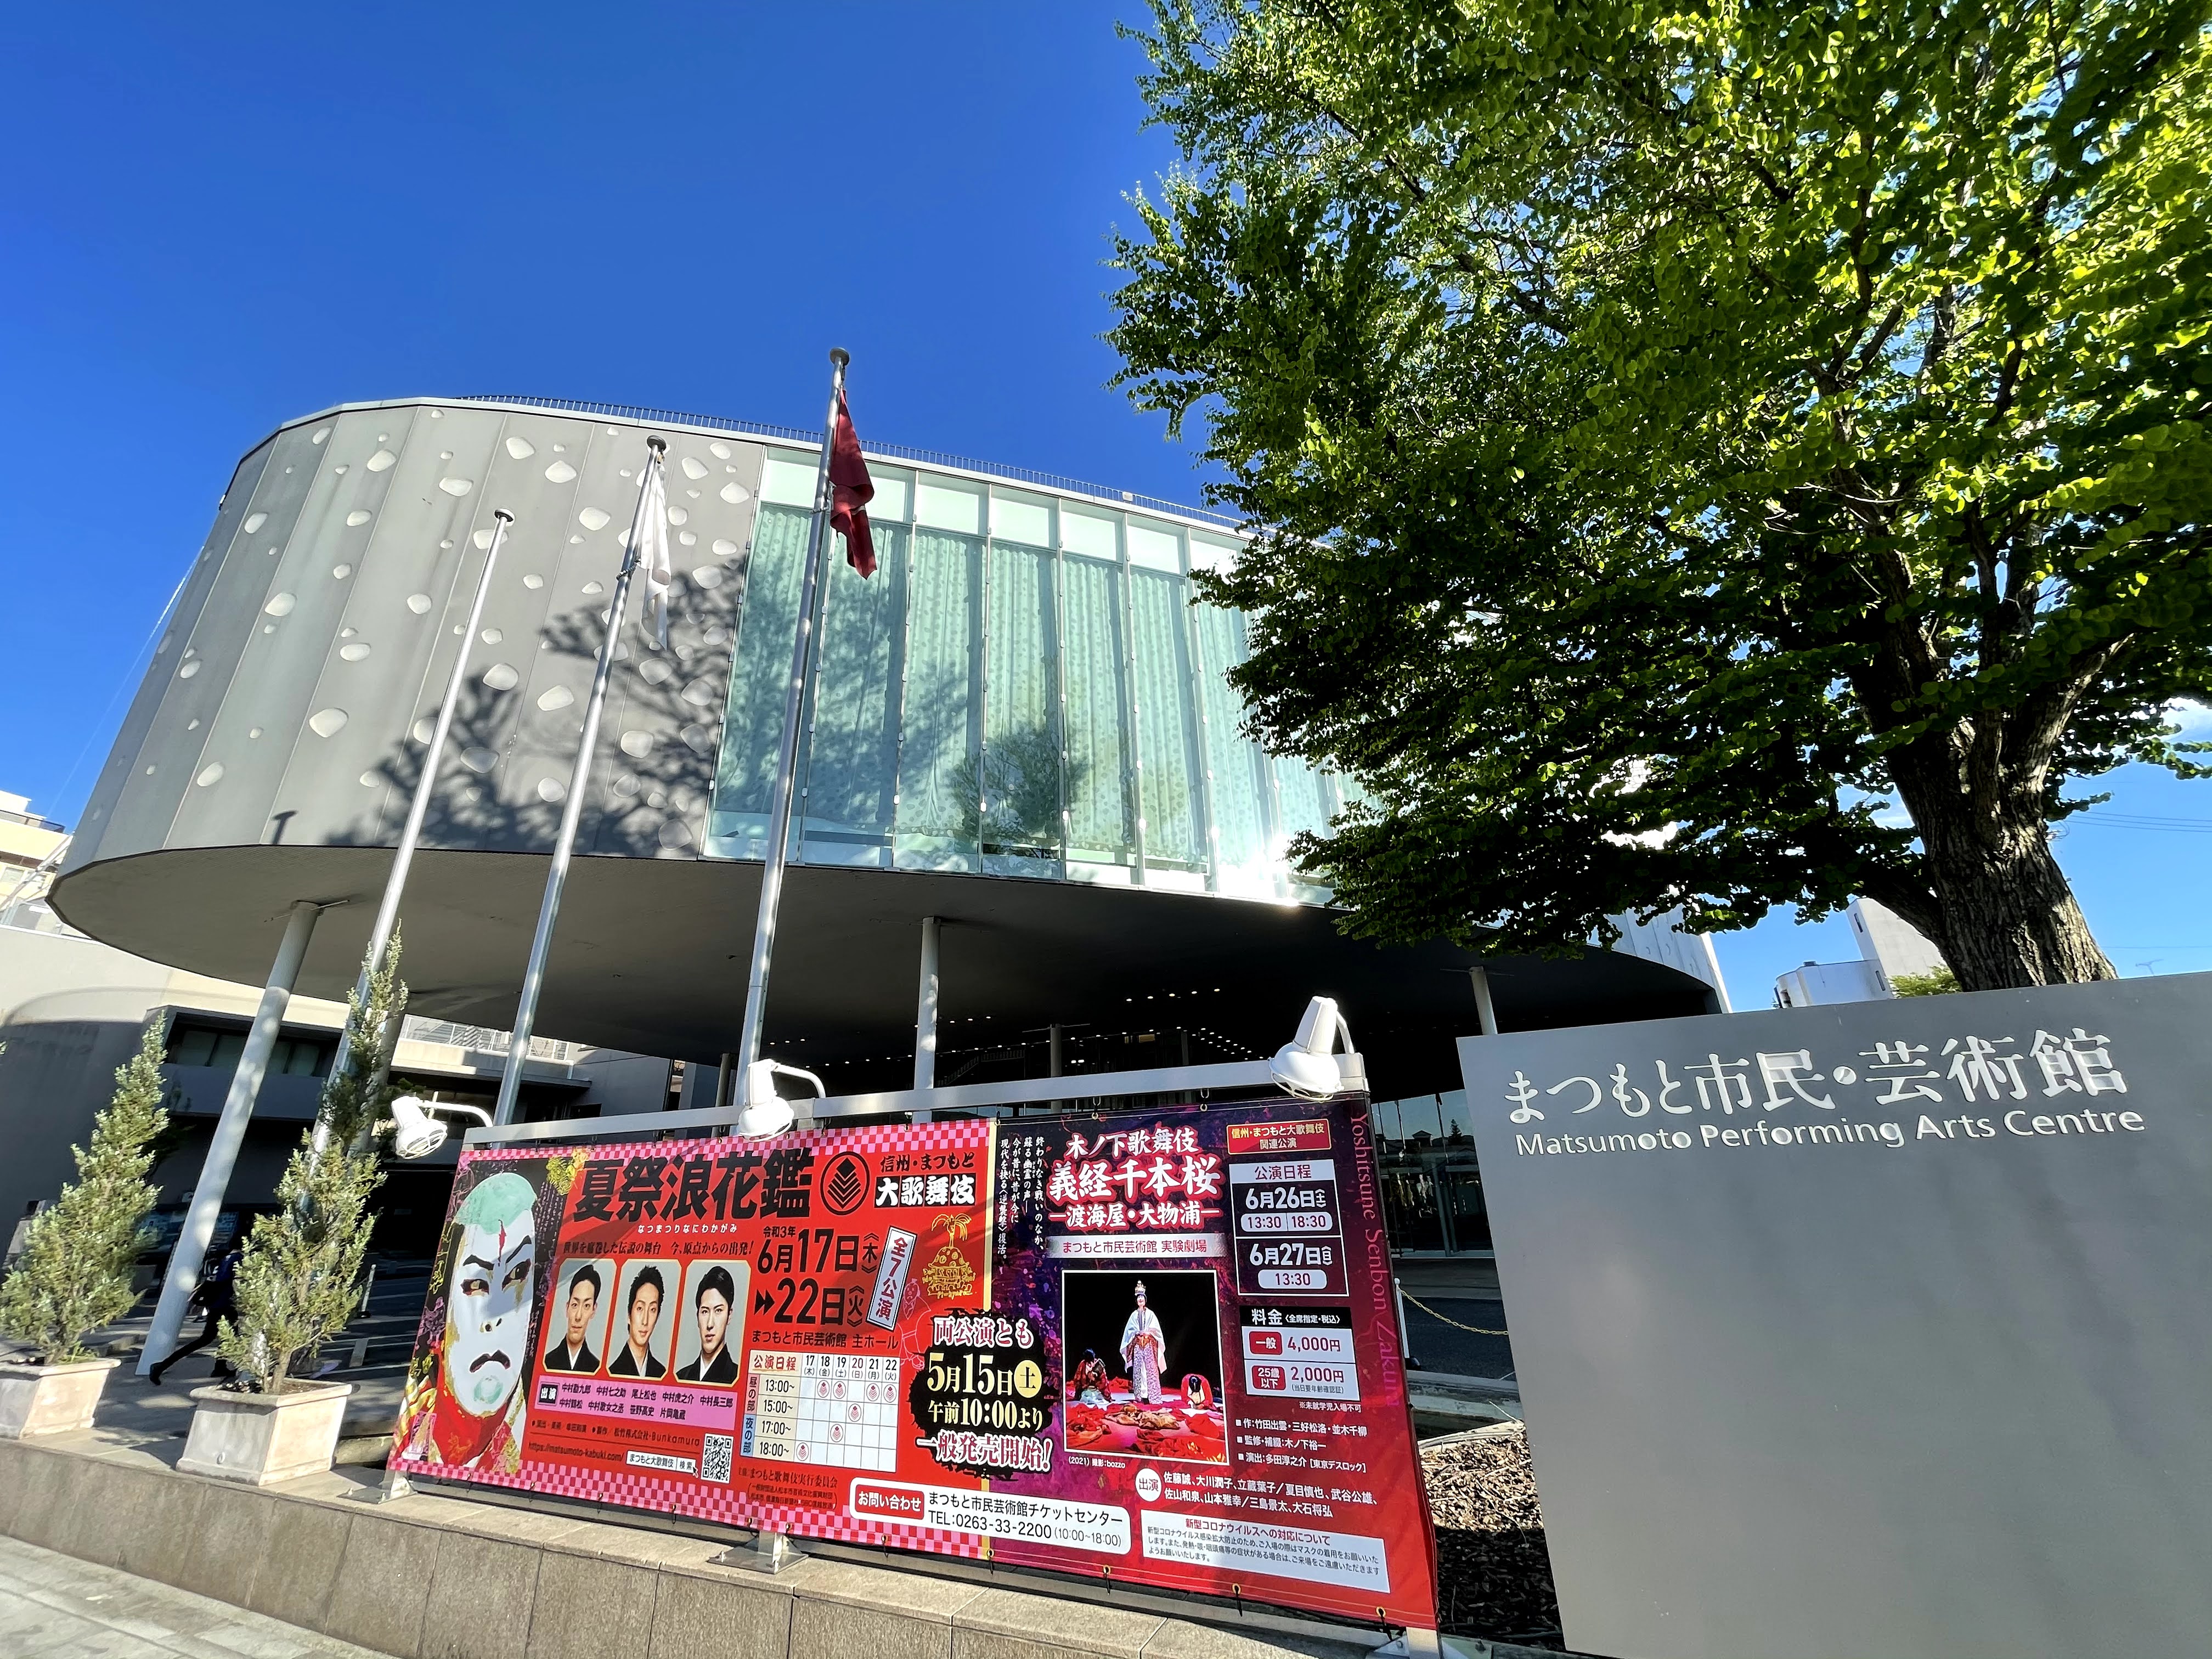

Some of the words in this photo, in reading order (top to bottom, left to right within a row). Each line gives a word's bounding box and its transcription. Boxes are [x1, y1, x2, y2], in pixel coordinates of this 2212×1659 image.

[1505, 1027, 2128, 1124] まつもと市民・芸術館
[1231, 1122, 1325, 1139] 信州・まつもと大歌舞伎
[1515, 1128, 1691, 1156] Matsumoto
[1700, 1116, 1905, 1148] Performing
[1916, 1112, 1996, 1141] Arts
[2004, 1105, 2146, 1136] Centre
[1065, 1127, 1199, 1160] 木ノ下歌舞伎
[1260, 1138, 1297, 1150] 関連公演
[881, 1151, 975, 1173] 信州・まつもと
[1255, 1164, 1312, 1180] 公演日程
[574, 1148, 814, 1222] 夏祭浪花鑑
[1010, 1137, 1021, 1223] 今が昔に、昔が今に
[1049, 1155, 1221, 1201] 義経千本桜
[876, 1173, 975, 1206] 大歌舞伎
[1248, 1216, 1281, 1229] 13:30
[1291, 1215, 1325, 1228] 18:30
[1350, 1114, 1376, 1221] Yoshitsune
[1365, 1229, 1390, 1310] Senbon
[638, 1223, 737, 1234] なつまつりなにわかがみ
[763, 1226, 795, 1238] 令和3年
[1063, 1240, 1157, 1253] まつもと市民芸術館
[1161, 1239, 1206, 1252] 実験劇場
[876, 1237, 908, 1321] 全7公演
[1275, 1273, 1311, 1285] 13:30
[1251, 1308, 1283, 1325] 料金
[752, 1330, 847, 1348] まつもと市民芸術館
[852, 1334, 899, 1349] 主ホール
[934, 1317, 1034, 1348] 両公演とも
[1255, 1337, 1277, 1350] 一般
[1288, 1336, 1340, 1352] 4,000円
[753, 1355, 796, 1371] 公演日程
[806, 1355, 815, 1365] 17
[821, 1356, 830, 1367] 18
[837, 1357, 847, 1368] 19
[852, 1358, 863, 1369] 20
[869, 1358, 878, 1370] 21
[885, 1359, 897, 1370] 22
[1257, 1367, 1279, 1378] 25歳
[804, 1367, 815, 1375] (木)
[819, 1368, 830, 1377] (金)
[836, 1369, 847, 1378] (土)
[851, 1370, 863, 1379] (日)
[868, 1371, 879, 1380] (月)
[884, 1372, 896, 1381] (火)
[1261, 1378, 1278, 1389] 以下
[1290, 1367, 1344, 1383] 2,000円
[747, 1376, 757, 1412] 昼の部
[928, 1398, 1042, 1431] 午前10:00より
[743, 1418, 754, 1453] 夜の部
[916, 1429, 1053, 1472] 一般発売開始!
[1068, 1456, 1090, 1466] (2021)
[1139, 1477, 1159, 1492] 出演
[858, 1491, 922, 1512] お問い合わせ
[929, 1491, 1123, 1526] まつもと市民芸術館チケットセンター
[928, 1510, 1052, 1538] TEL:0263-33-2200
[1186, 1518, 1330, 1546] 新型コロナウイルスへの対応について
